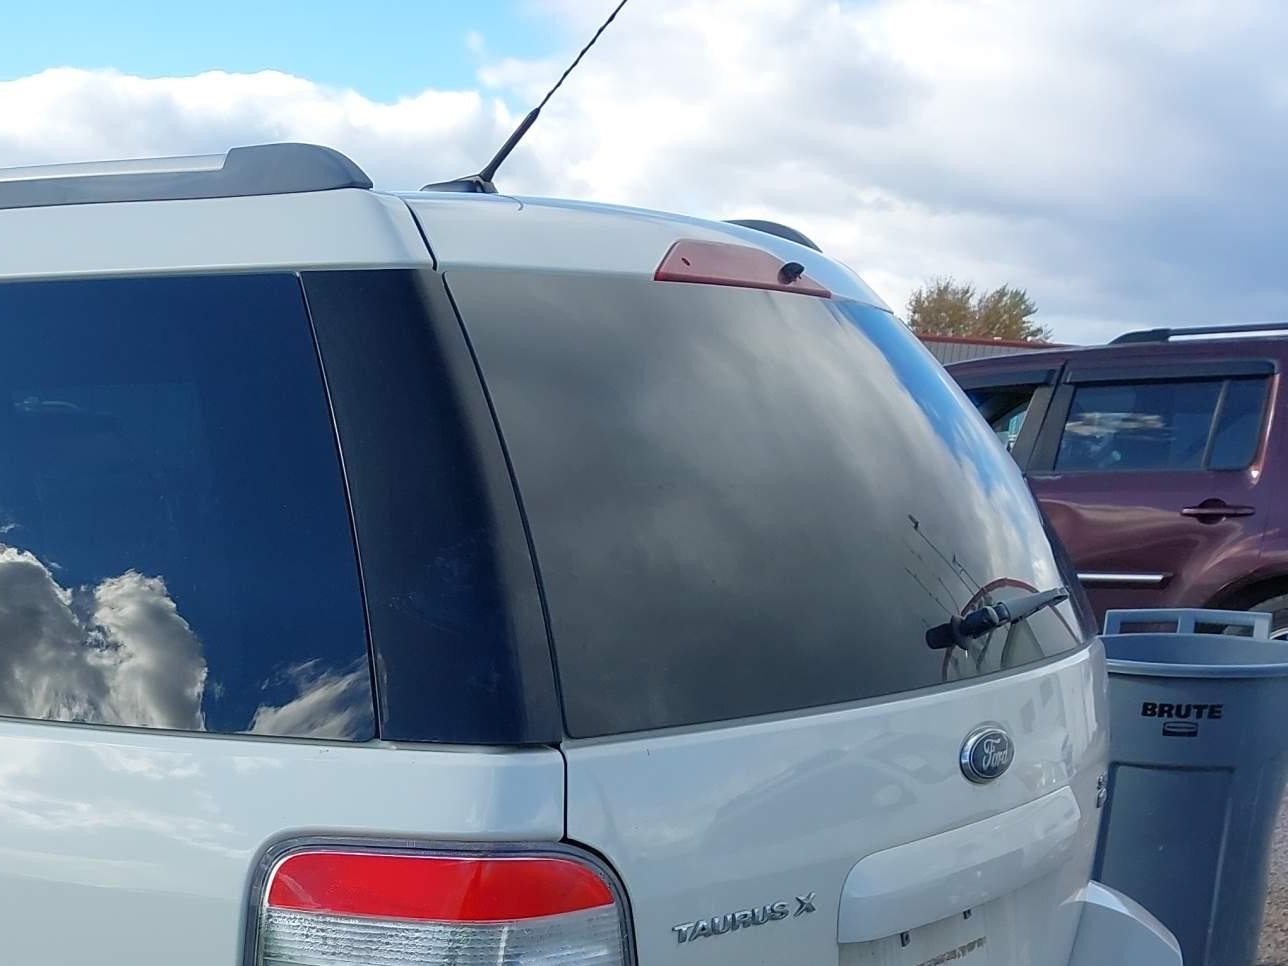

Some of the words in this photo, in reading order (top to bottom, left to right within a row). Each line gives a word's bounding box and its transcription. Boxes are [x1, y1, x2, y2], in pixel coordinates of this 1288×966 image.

[1141, 702, 1223, 720] BRUTE
[982, 738, 1009, 771] Ford
[672, 901, 789, 944] TAURUS
[793, 892, 817, 917] X
